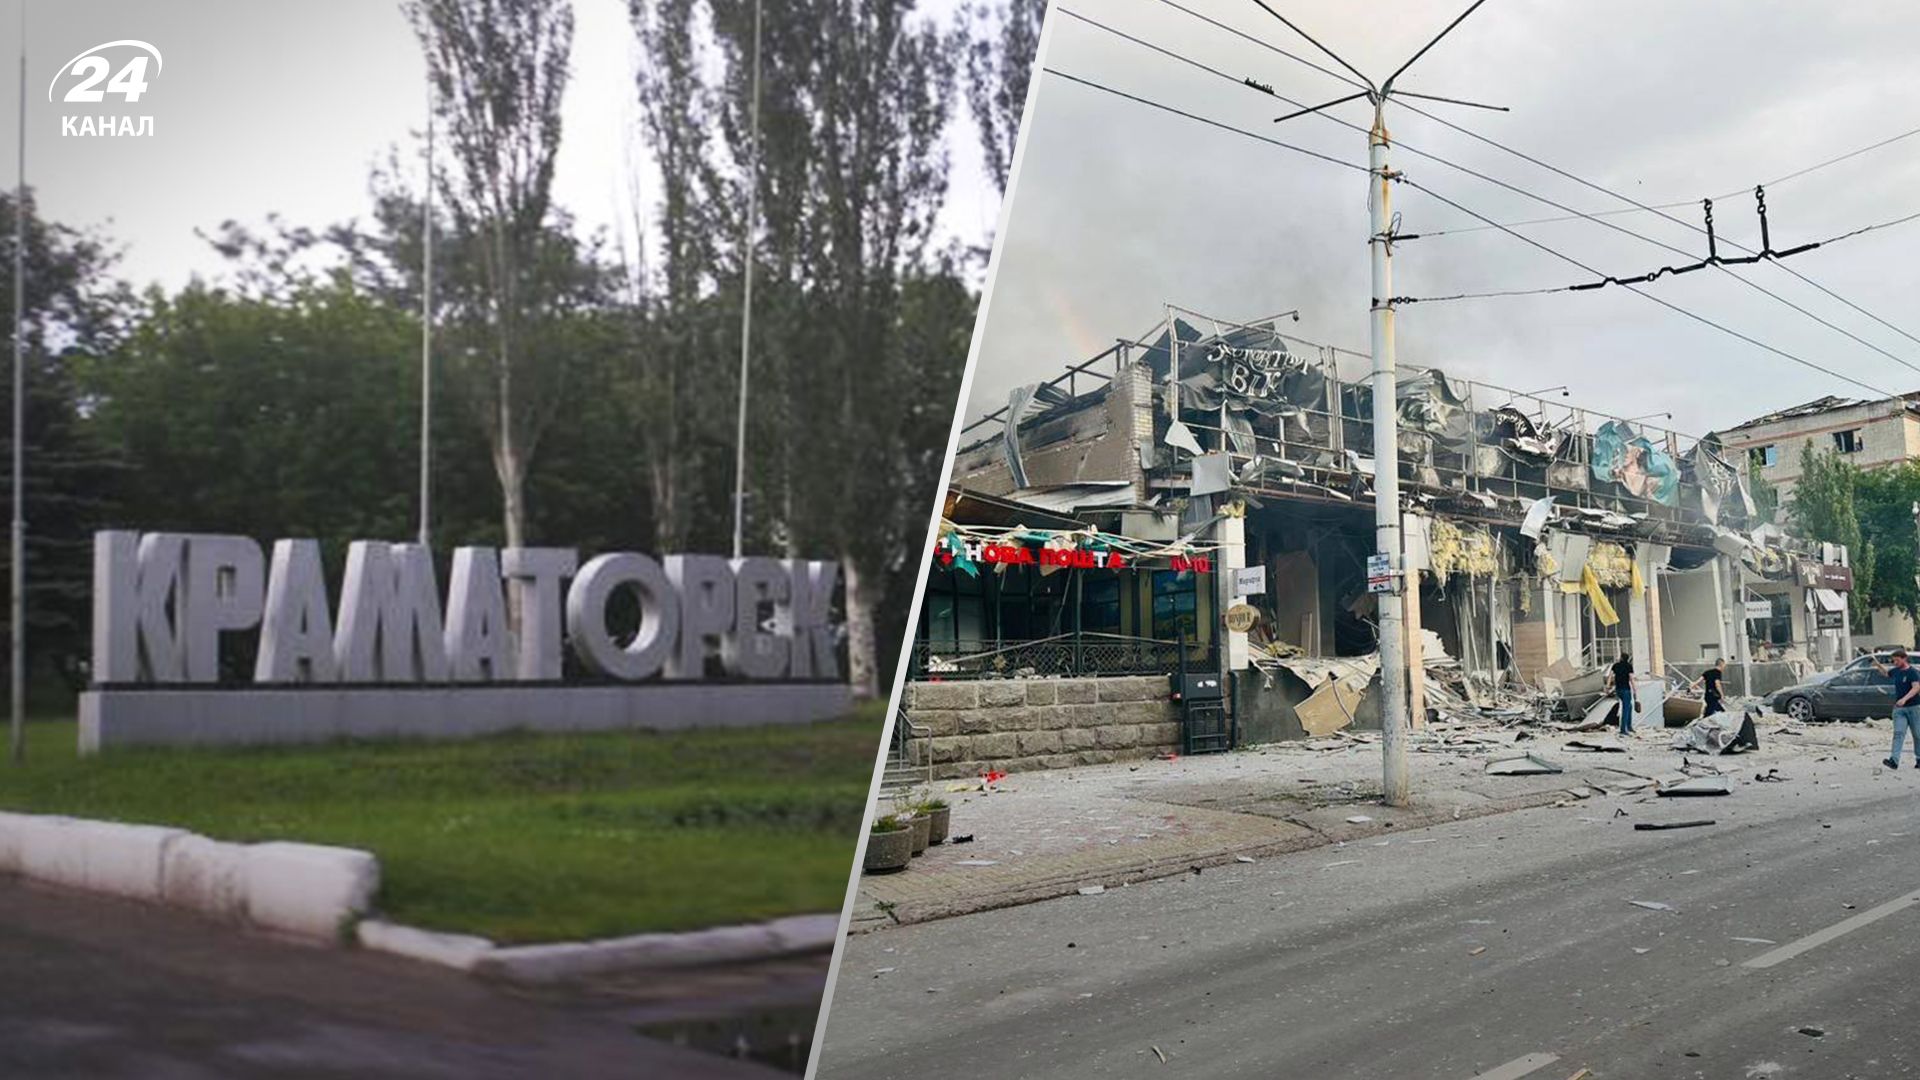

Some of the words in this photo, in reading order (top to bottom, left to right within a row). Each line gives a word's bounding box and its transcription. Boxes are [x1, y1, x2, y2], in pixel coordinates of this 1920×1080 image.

[964, 542, 1033, 564] НОВА
[1039, 546, 1126, 569] ПОШТА
[93, 529, 839, 684] КРАМАТОРСК
